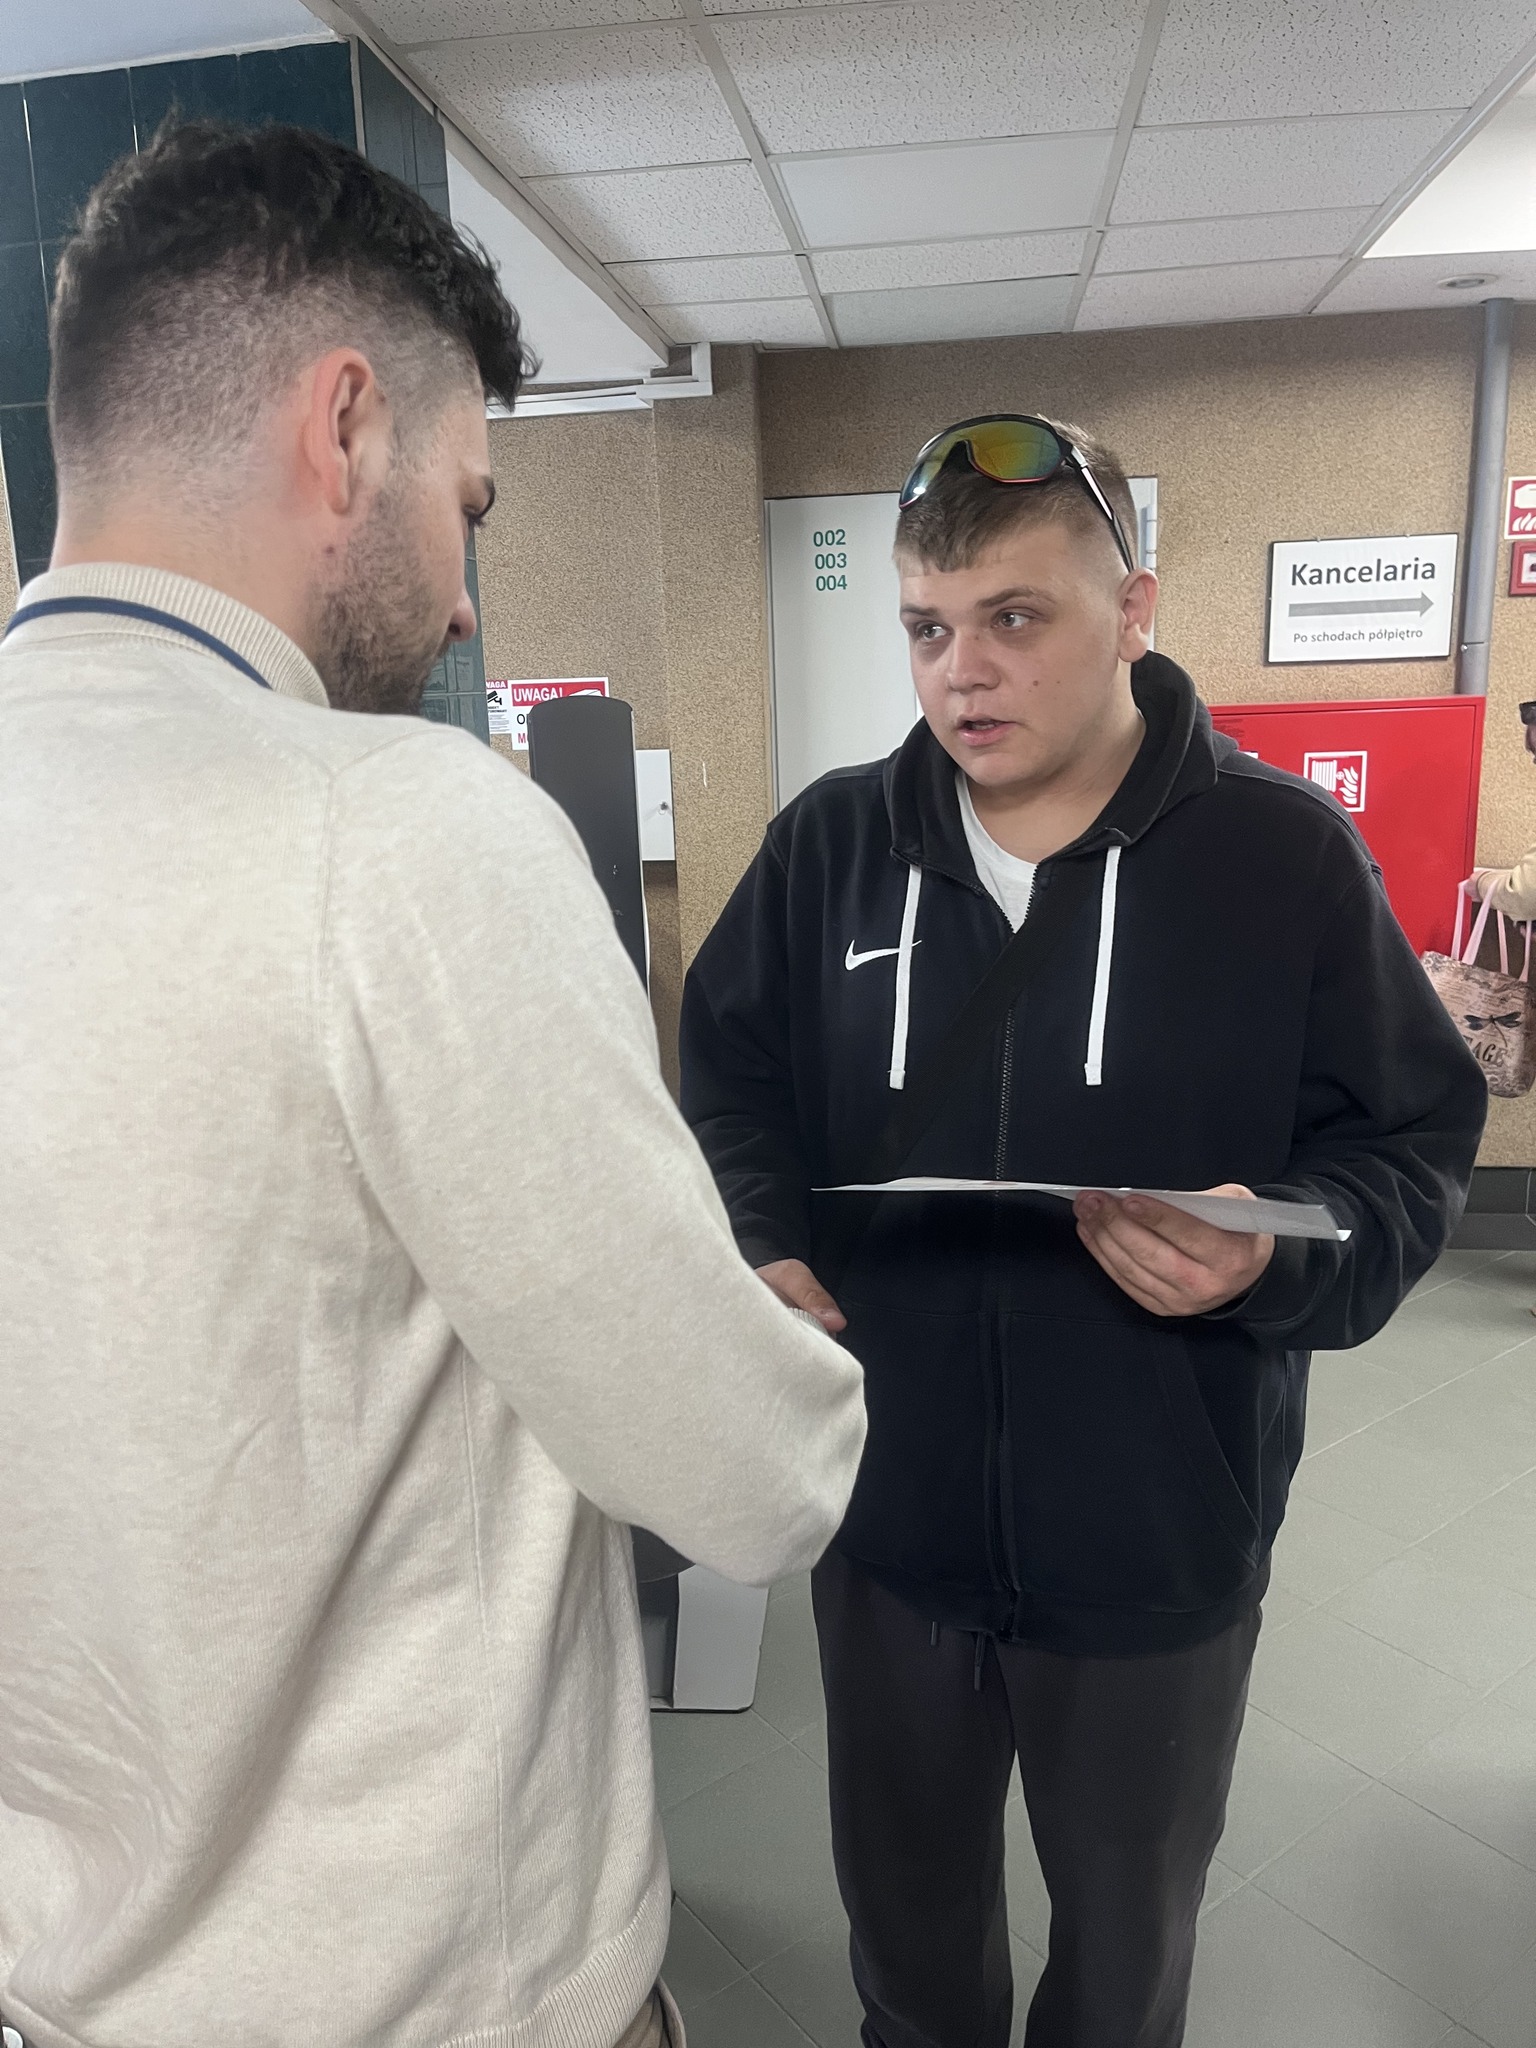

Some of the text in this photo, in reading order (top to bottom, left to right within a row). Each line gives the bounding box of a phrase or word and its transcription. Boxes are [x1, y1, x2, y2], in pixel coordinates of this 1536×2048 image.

[813, 529, 846, 547] 002
[815, 553, 847, 570] 003
[1291, 557, 1436, 586] Kancelaria
[816, 575, 848, 591] 004
[1293, 628, 1424, 643] Po schodach półpiętro
